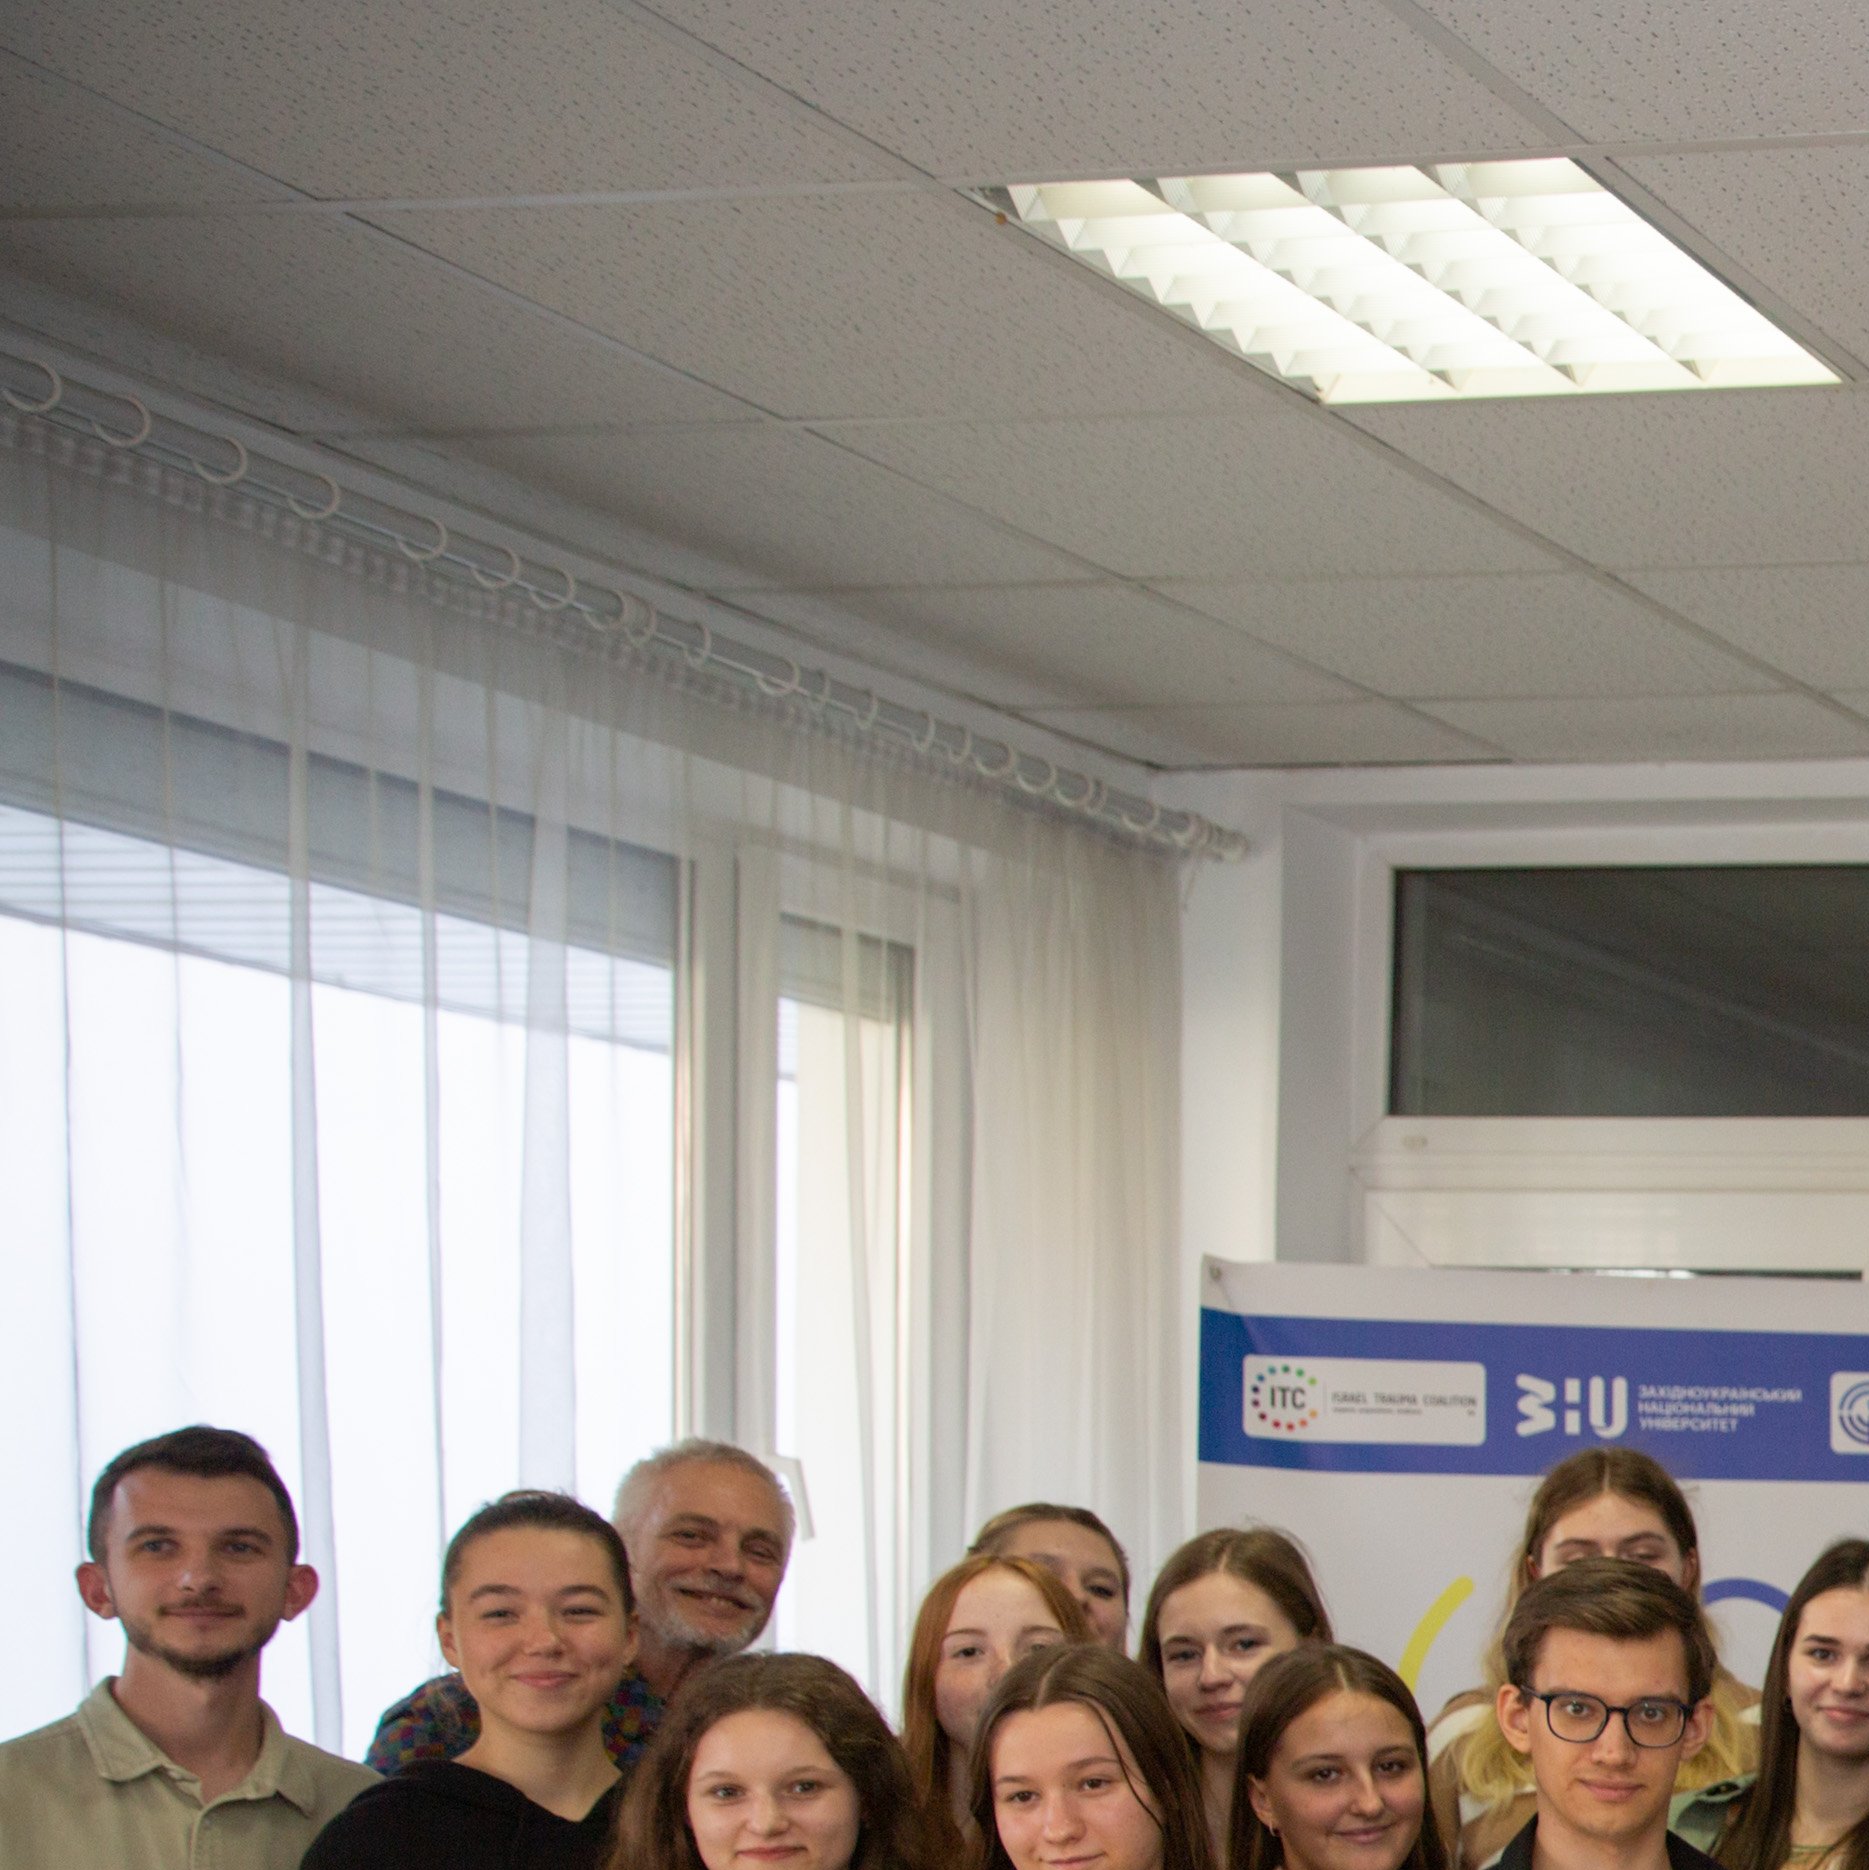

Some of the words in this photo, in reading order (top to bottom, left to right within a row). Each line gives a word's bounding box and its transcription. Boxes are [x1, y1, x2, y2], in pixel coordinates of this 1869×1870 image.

[1270, 1386, 1306, 1410] ITC
[1331, 1392, 1369, 1405] ISRAEL
[1373, 1392, 1418, 1405] TRAUMA
[1423, 1394, 1477, 1406] COALITION
